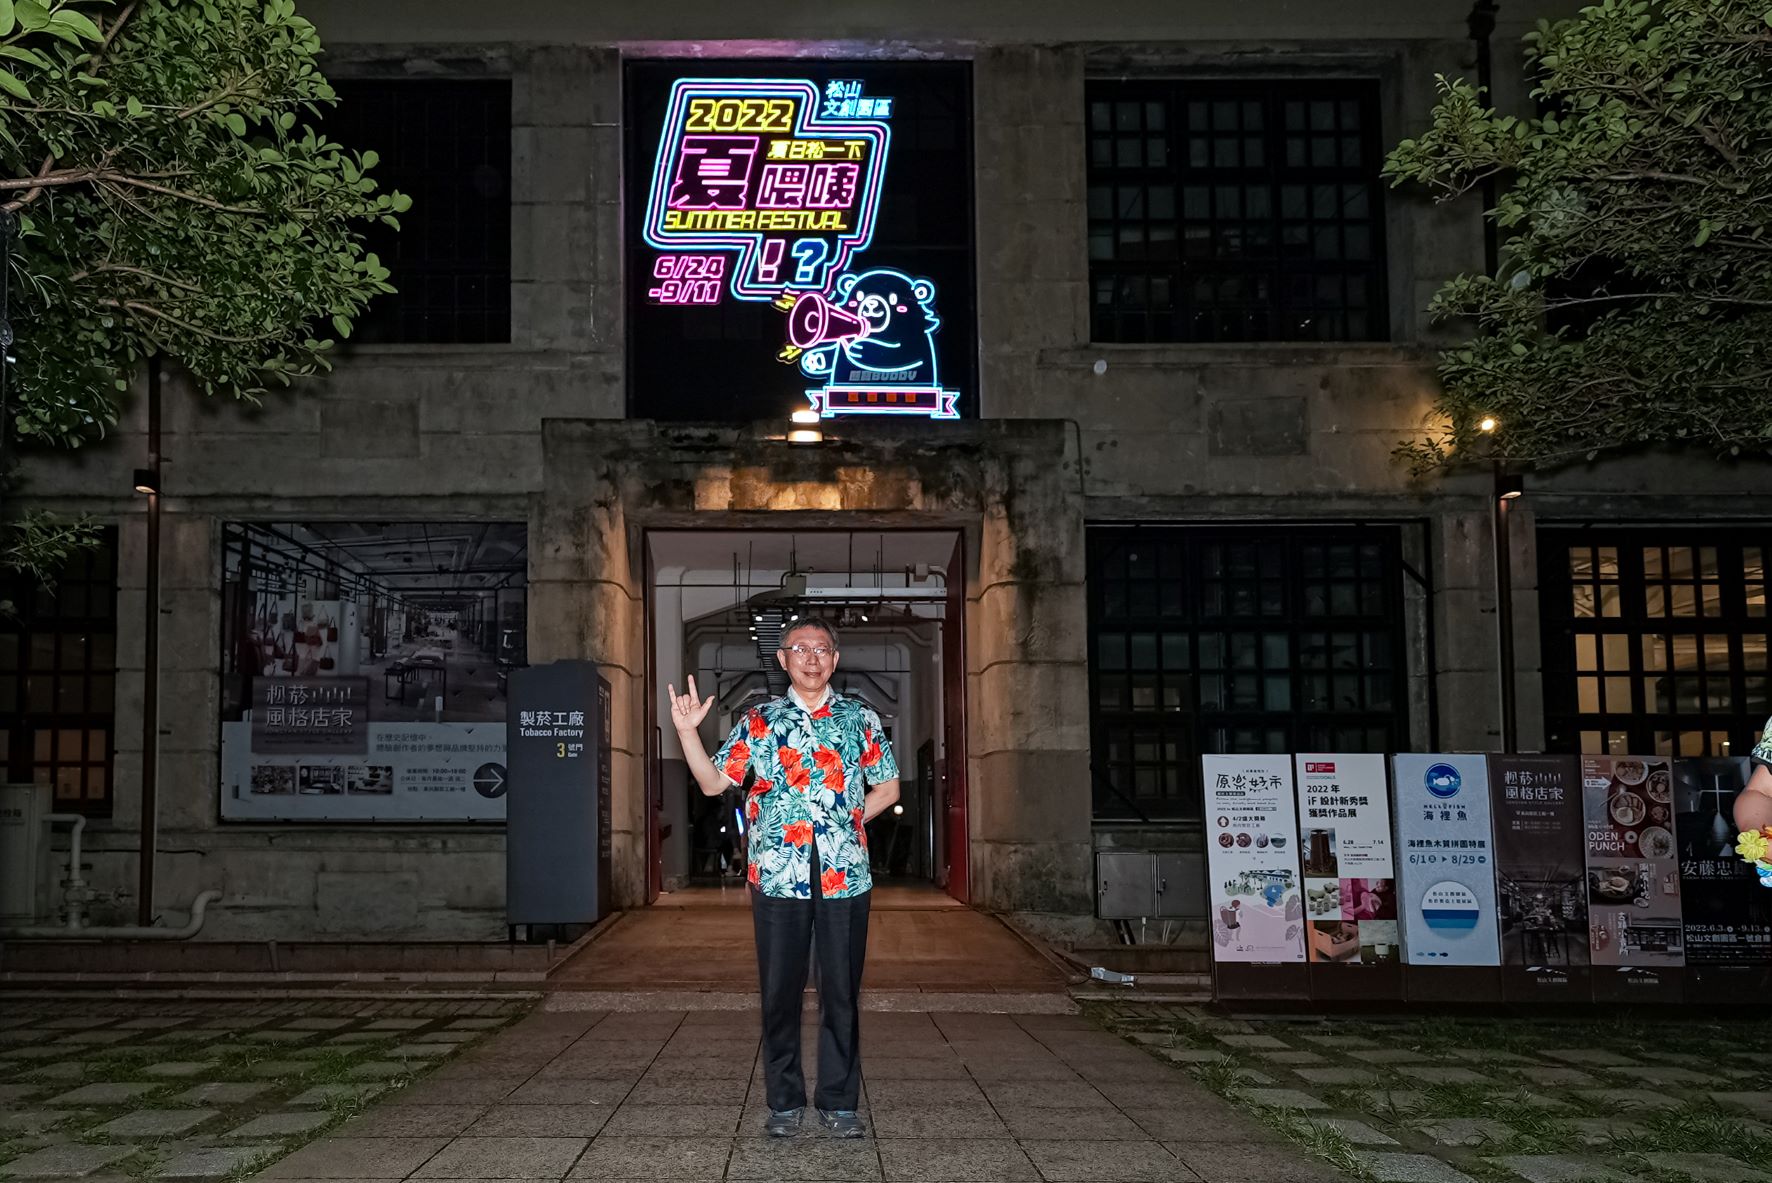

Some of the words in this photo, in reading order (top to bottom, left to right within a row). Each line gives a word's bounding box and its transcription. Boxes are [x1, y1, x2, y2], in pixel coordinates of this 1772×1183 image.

[825, 80, 862, 99] 松山
[685, 99, 795, 132] 2022
[820, 98, 893, 117] 文創園區
[767, 140, 866, 159] 夏日松一下
[664, 210, 755, 229] SUMMER
[757, 211, 847, 229] FESTIVAL
[653, 256, 725, 278] 6/24
[265, 706, 353, 727] 風格店家
[519, 710, 584, 727] 製菸工廠
[520, 727, 552, 738] Tobacco
[553, 727, 584, 740] Factory
[556, 742, 566, 759] 3
[567, 743, 583, 752] 號門
[1307, 785, 1328, 793] 2022
[1330, 784, 1341, 794] 年
[1505, 785, 1564, 801] 風格店家
[1320, 796, 1369, 806] 設計新秀獎
[1308, 808, 1357, 818] 獲獎作品展
[1423, 810, 1467, 821] 海裡魚
[1588, 831, 1619, 841] ODEN
[1588, 841, 1625, 852] PUNCH
[1452, 854, 1475, 866] 8/29
